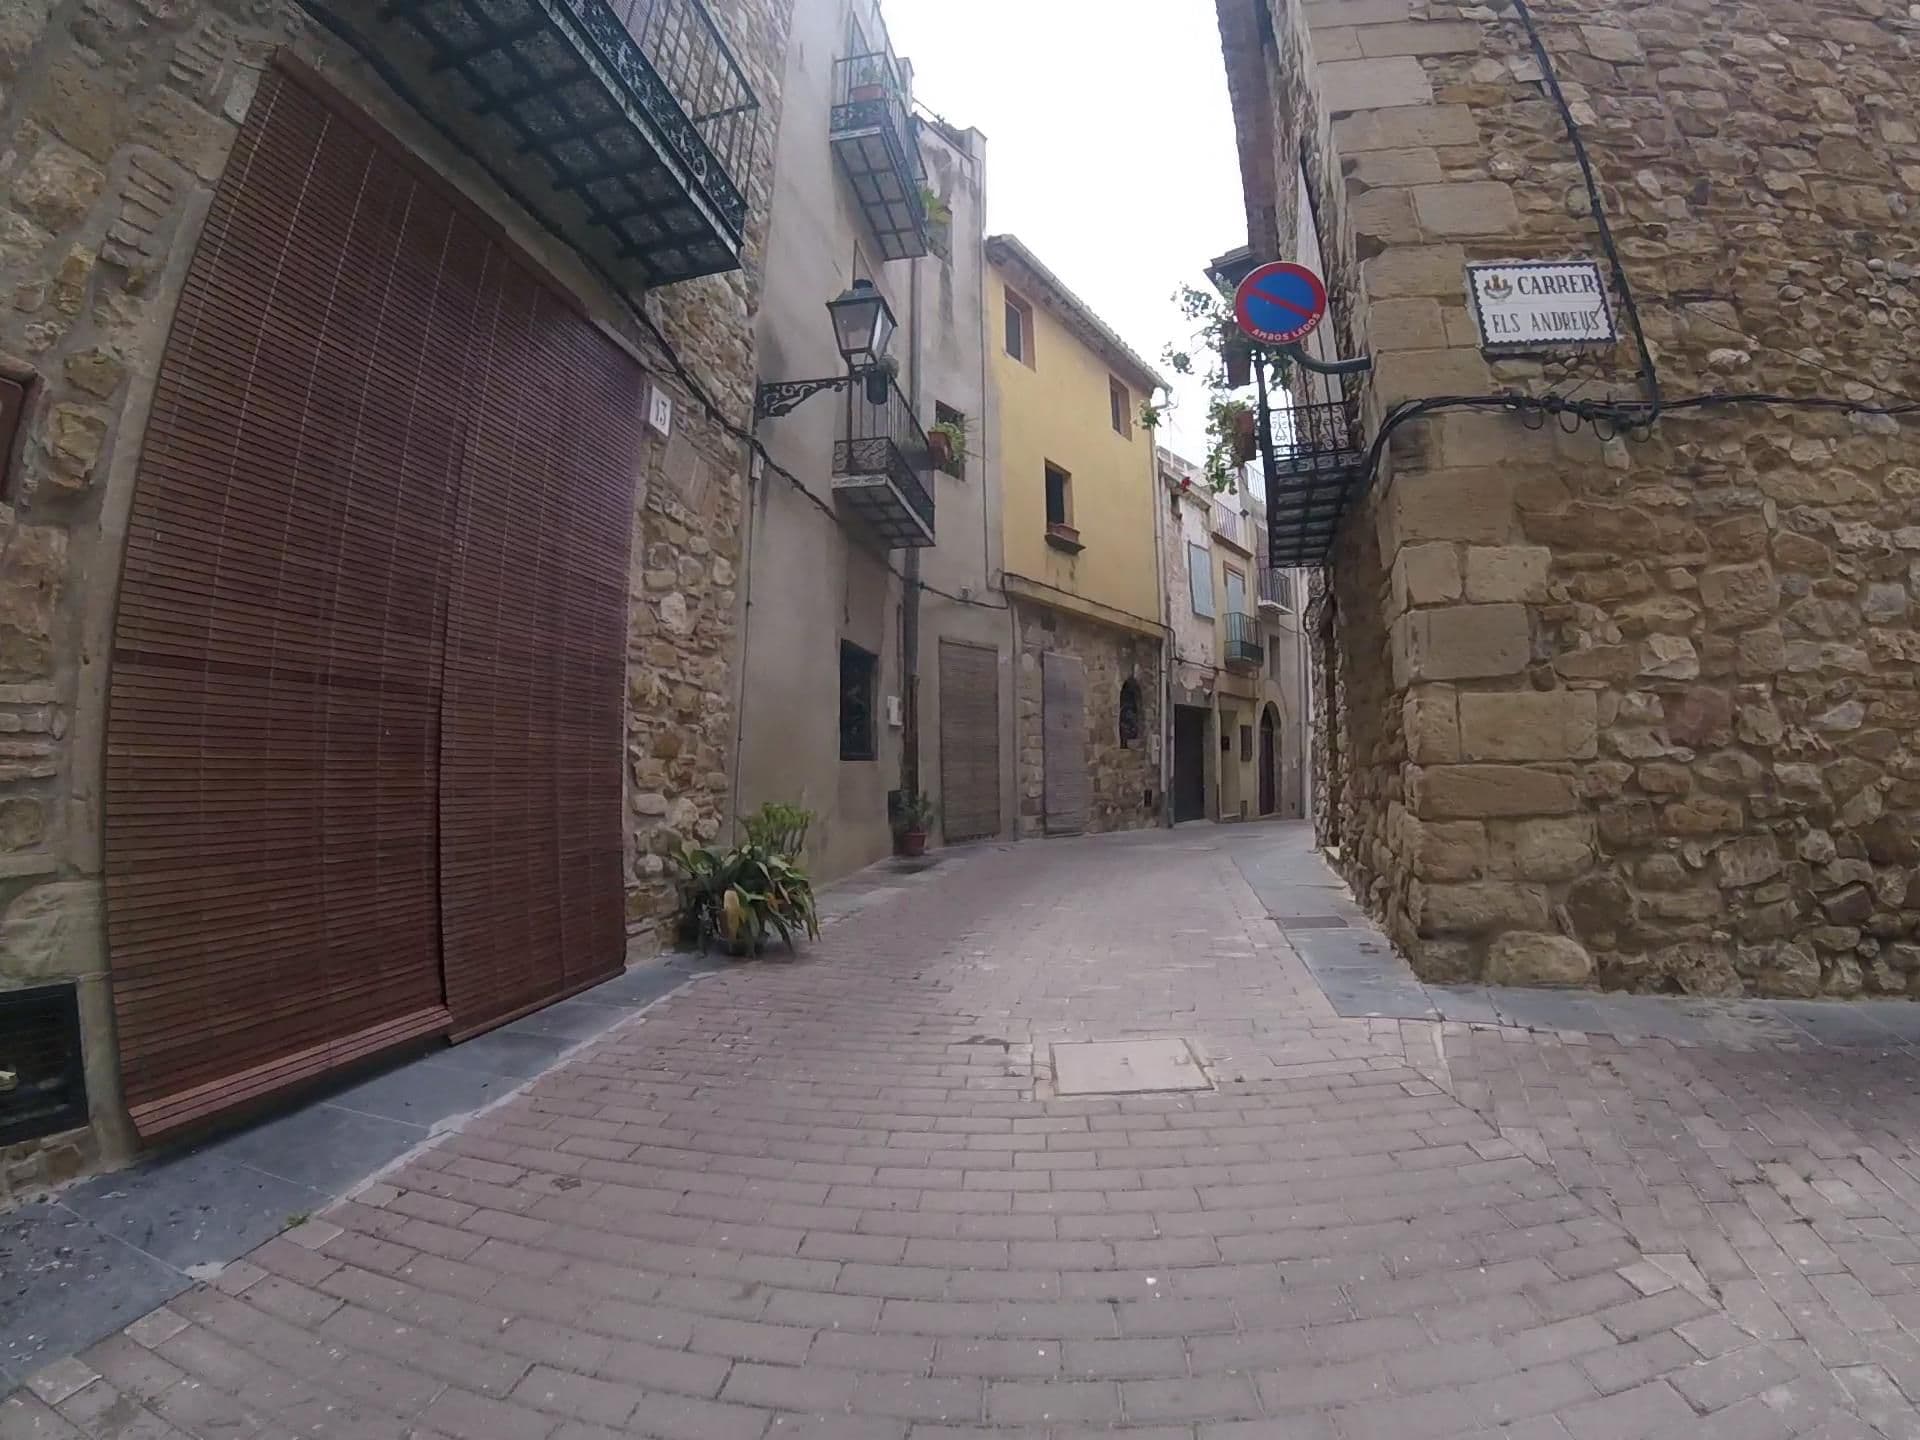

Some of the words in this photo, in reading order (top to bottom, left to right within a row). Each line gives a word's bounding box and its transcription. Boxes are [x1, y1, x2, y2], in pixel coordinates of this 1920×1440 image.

[1517, 273, 1597, 295] CARRER
[1251, 328, 1289, 341] AMBOS
[1292, 312, 1320, 337] LADOS
[1491, 312, 1521, 333] ELS
[1530, 310, 1600, 332] ANDREUS
